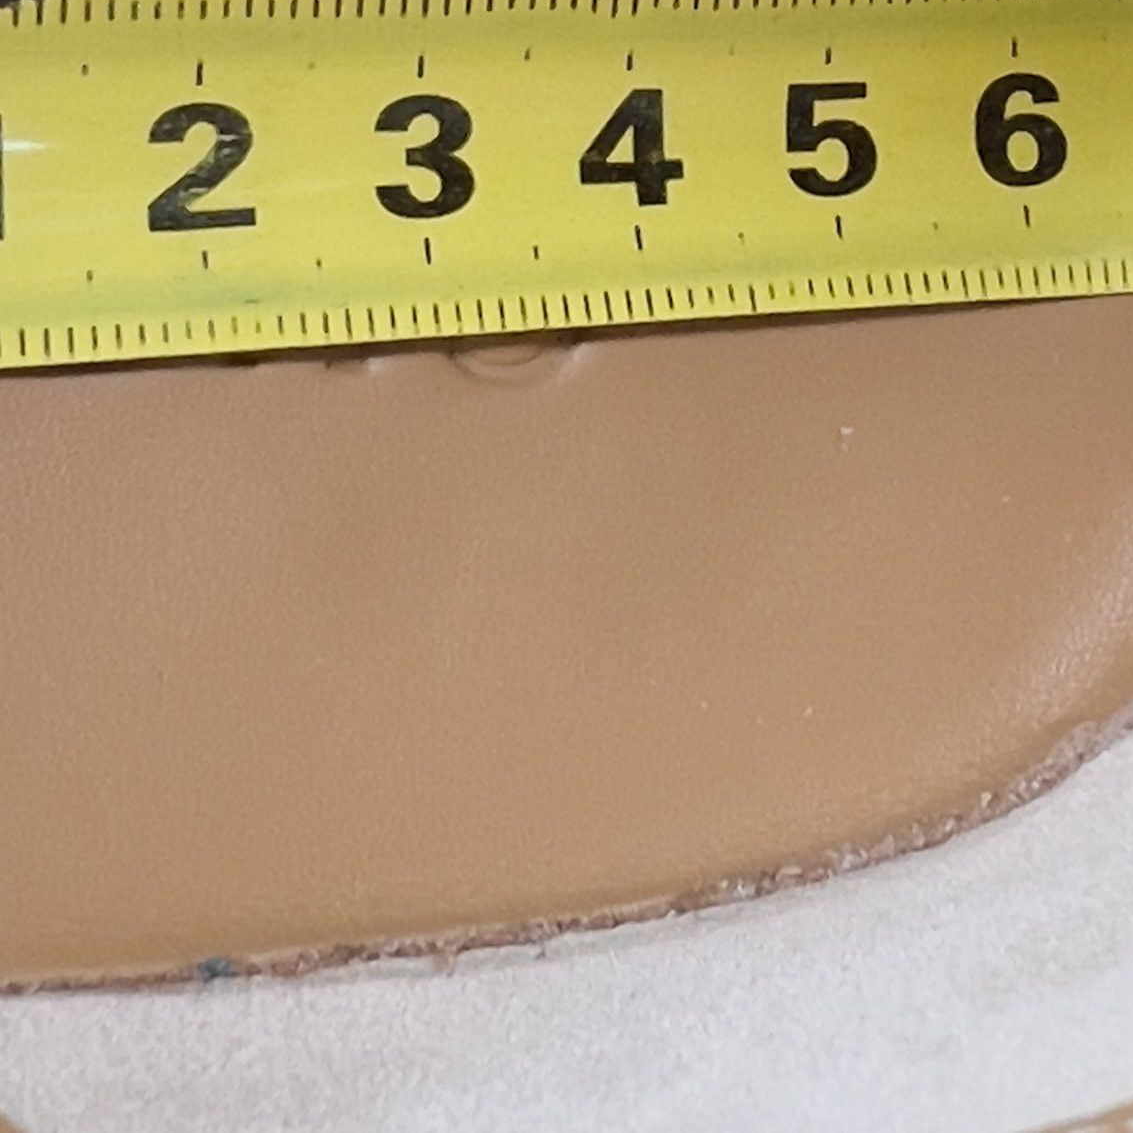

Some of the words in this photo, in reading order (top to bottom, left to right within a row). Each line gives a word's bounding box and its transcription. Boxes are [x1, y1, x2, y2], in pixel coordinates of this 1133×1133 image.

[147, 102, 257, 232] 2
[374, 94, 475, 219] 3
[579, 88, 684, 207] 4
[785, 81, 878, 198] 5
[974, 72, 1068, 188] 6
